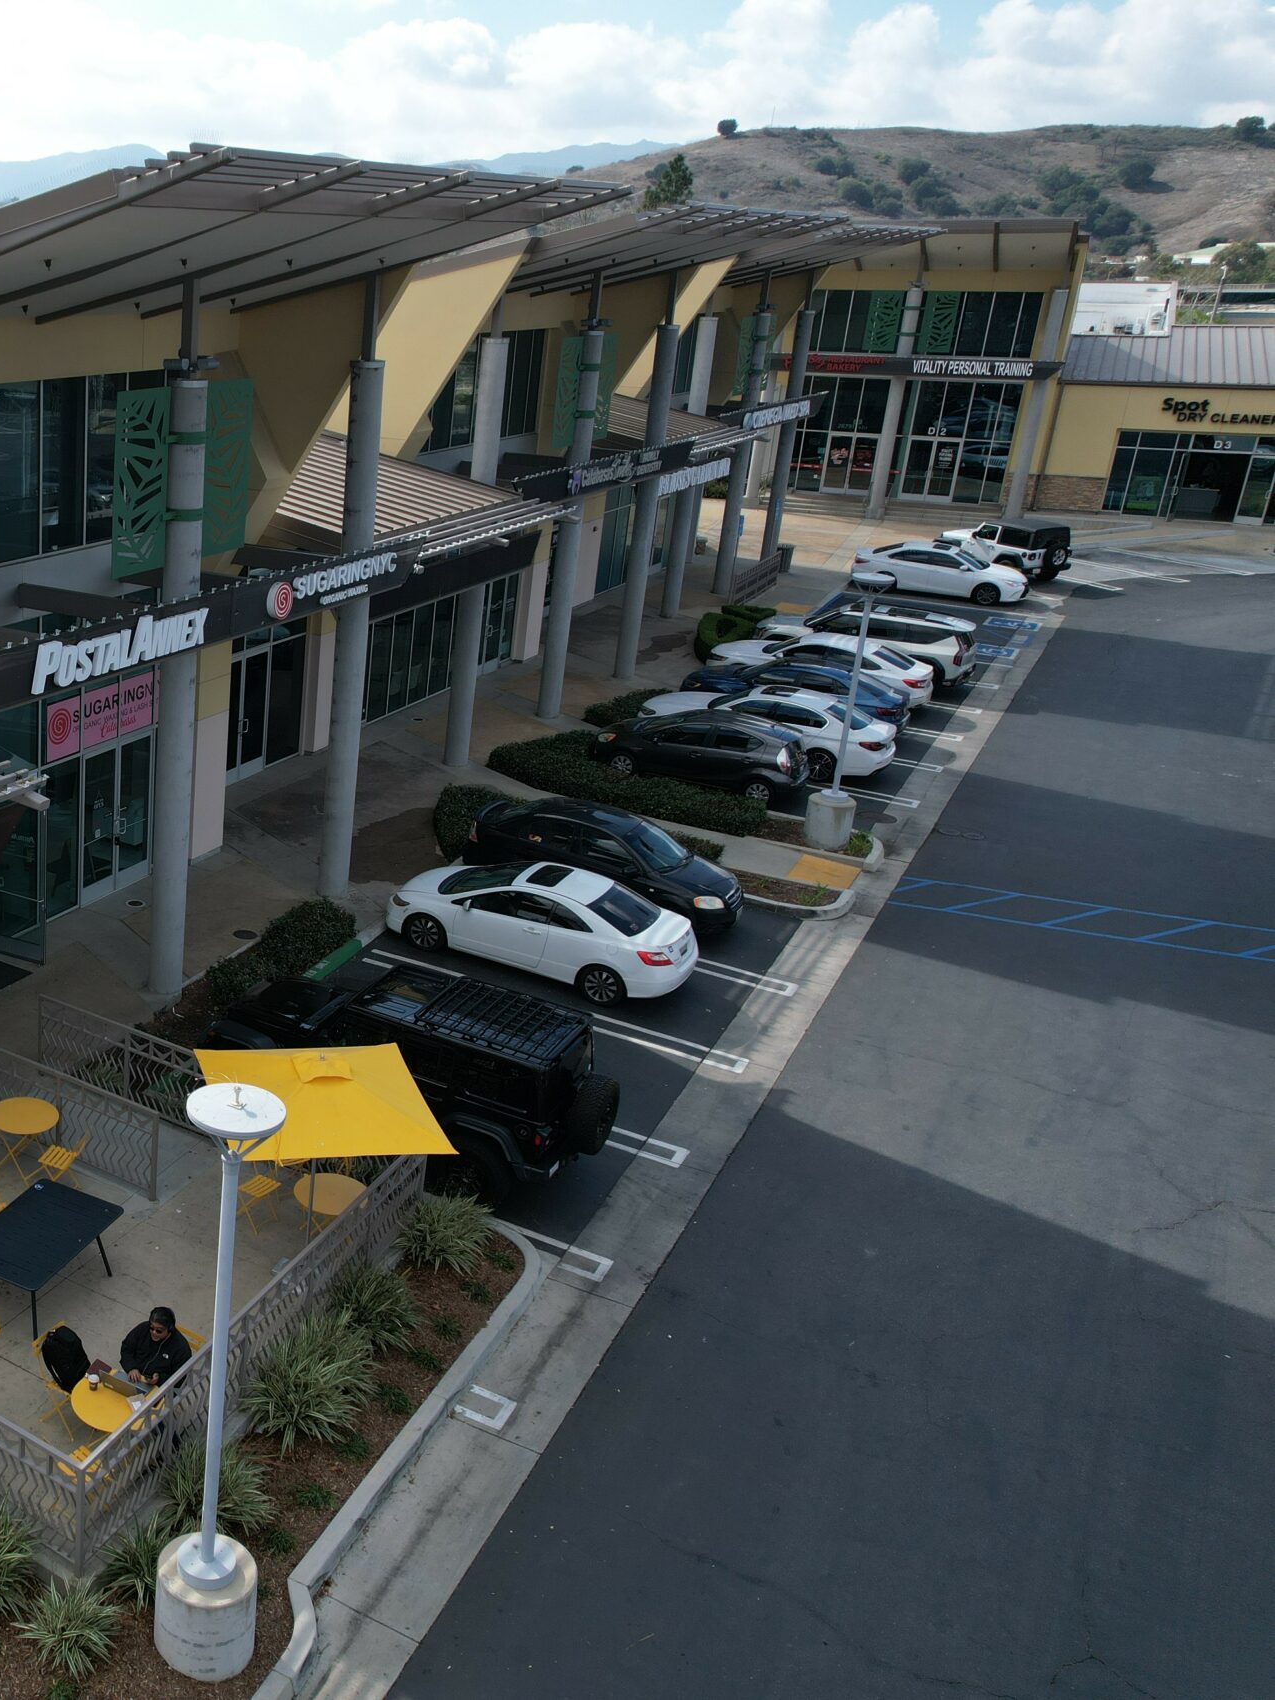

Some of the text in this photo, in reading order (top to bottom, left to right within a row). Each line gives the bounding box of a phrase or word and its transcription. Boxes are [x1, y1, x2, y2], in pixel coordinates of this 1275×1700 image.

[826, 363, 861, 373] BAKERY
[913, 359, 1034, 377] VITALITY PERSONAL TRAINING
[1161, 397, 1210, 414] Spot
[1177, 412, 1207, 423] DRY
[292, 551, 398, 600] SUGARINGNYC
